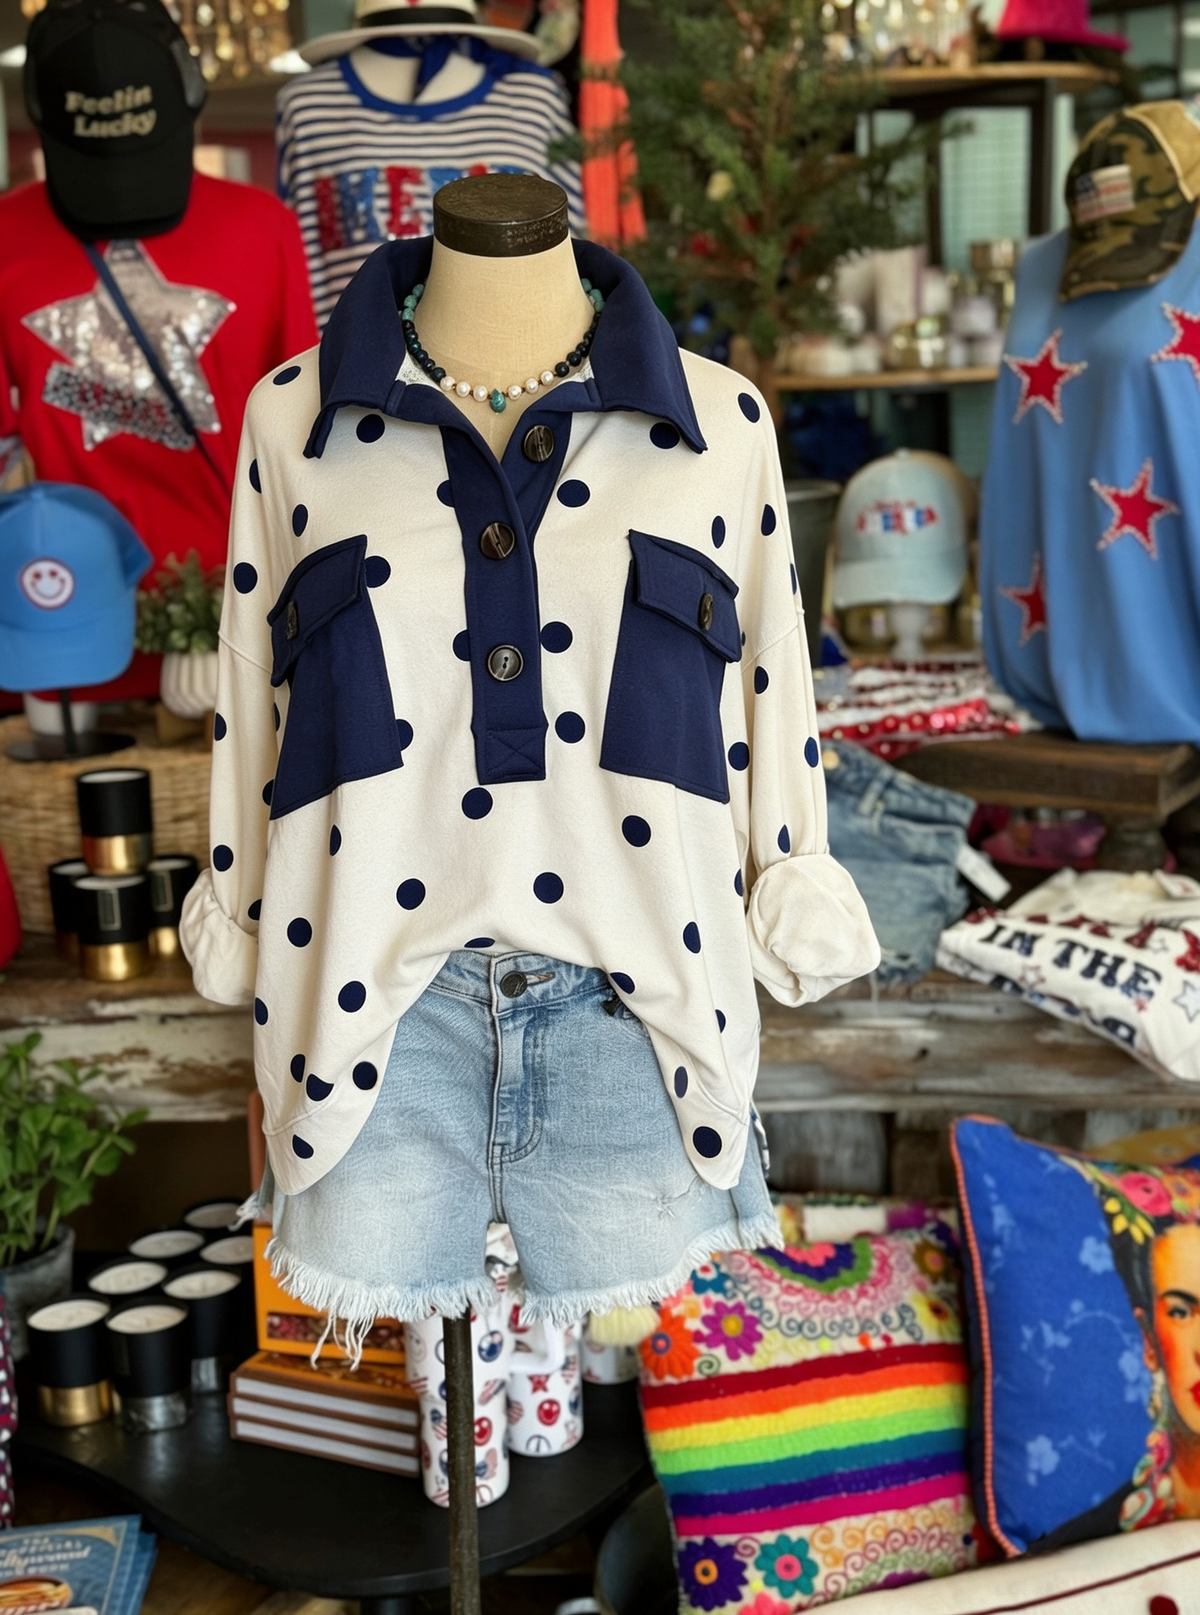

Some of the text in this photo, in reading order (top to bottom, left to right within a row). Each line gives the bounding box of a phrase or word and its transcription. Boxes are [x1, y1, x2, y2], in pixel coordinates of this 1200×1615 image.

[65, 85, 152, 114] Feelin
[75, 109, 156, 138] Lucky
[979, 924, 1044, 957] IN
[1053, 938, 1162, 1001] THE
